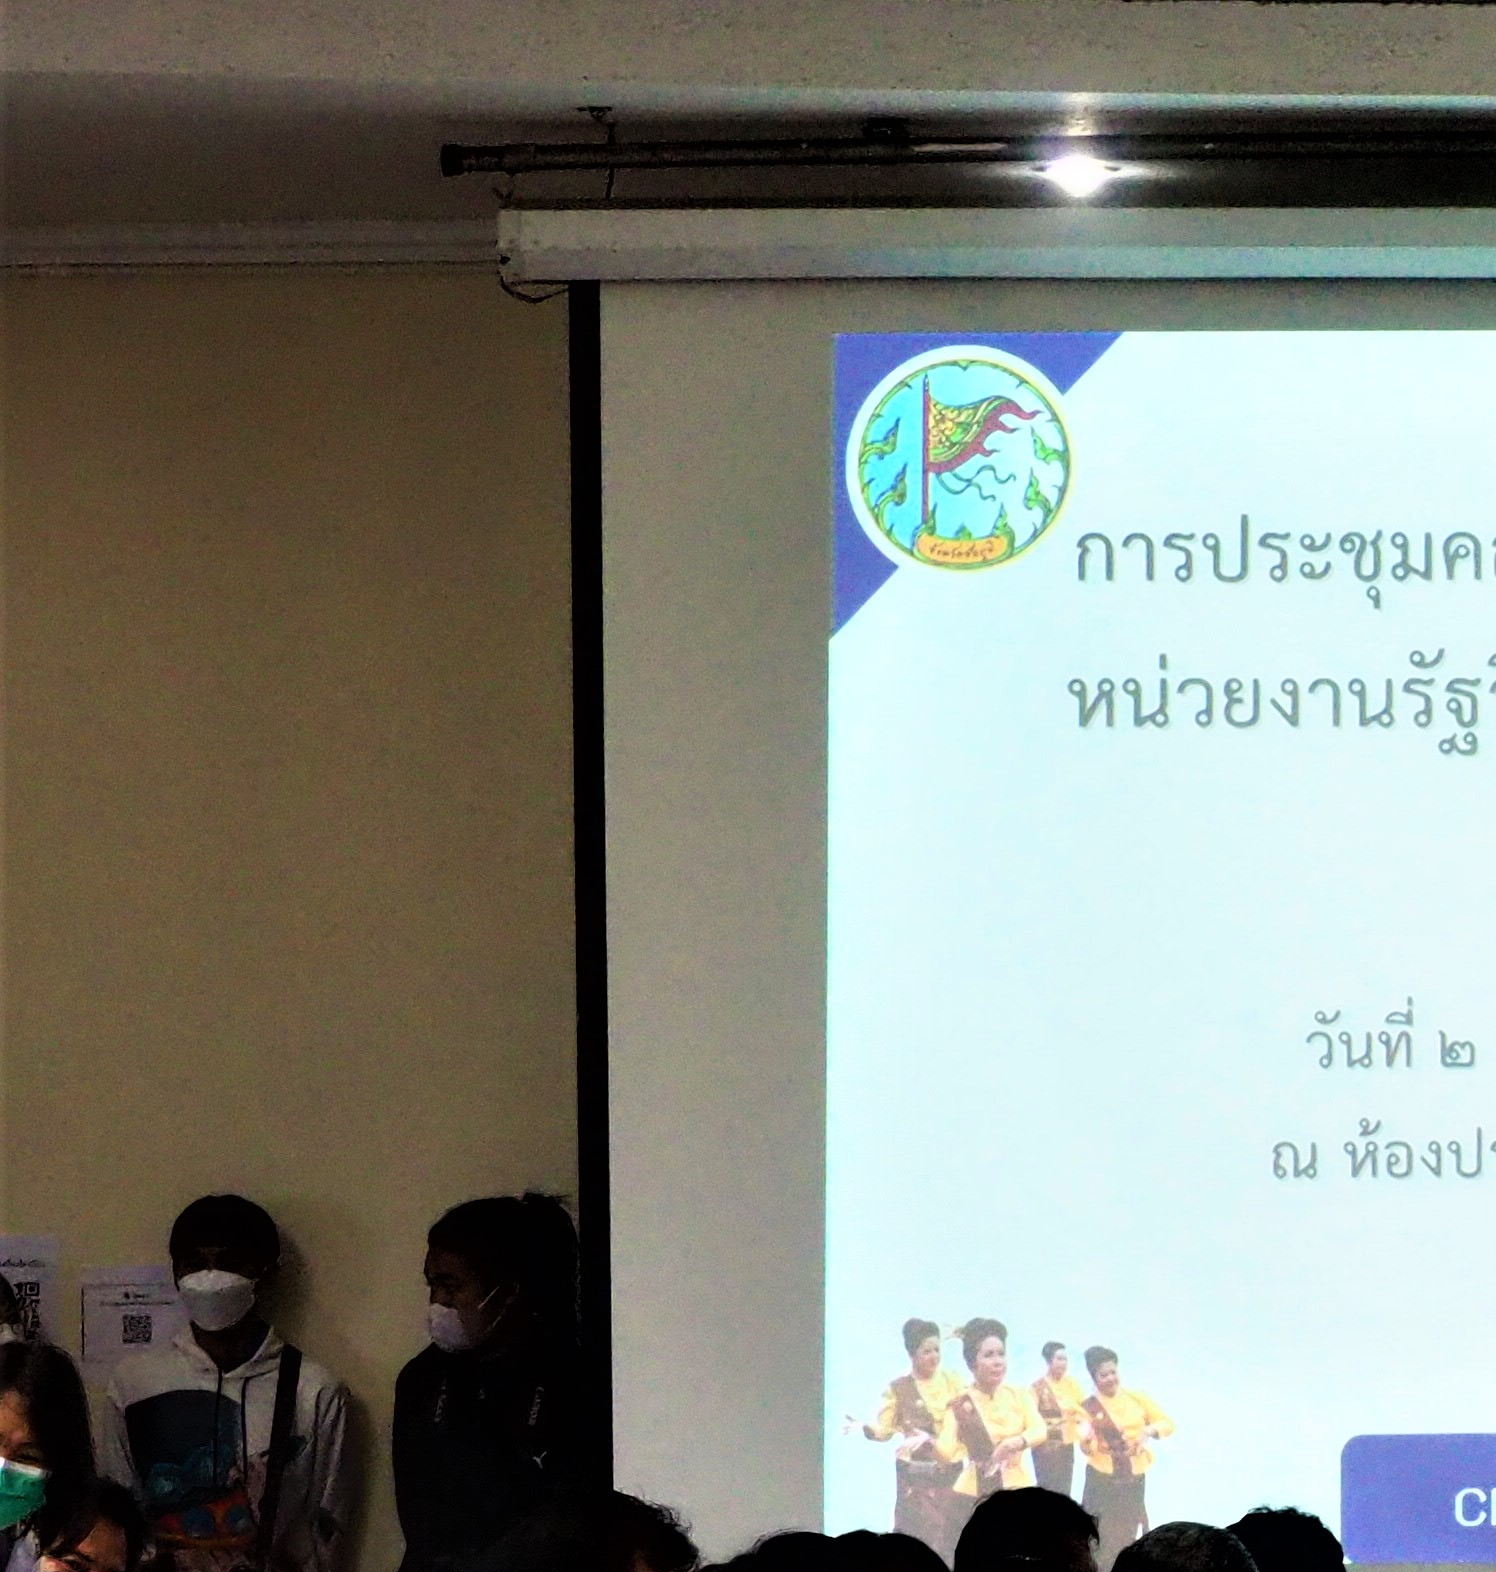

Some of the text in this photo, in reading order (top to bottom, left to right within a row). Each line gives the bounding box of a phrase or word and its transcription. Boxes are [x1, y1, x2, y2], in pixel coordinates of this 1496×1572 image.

[1305, 995, 1415, 1070] วันที่
[1438, 1029, 1477, 1070] ๒
[1272, 1141, 1319, 1181] ณ
